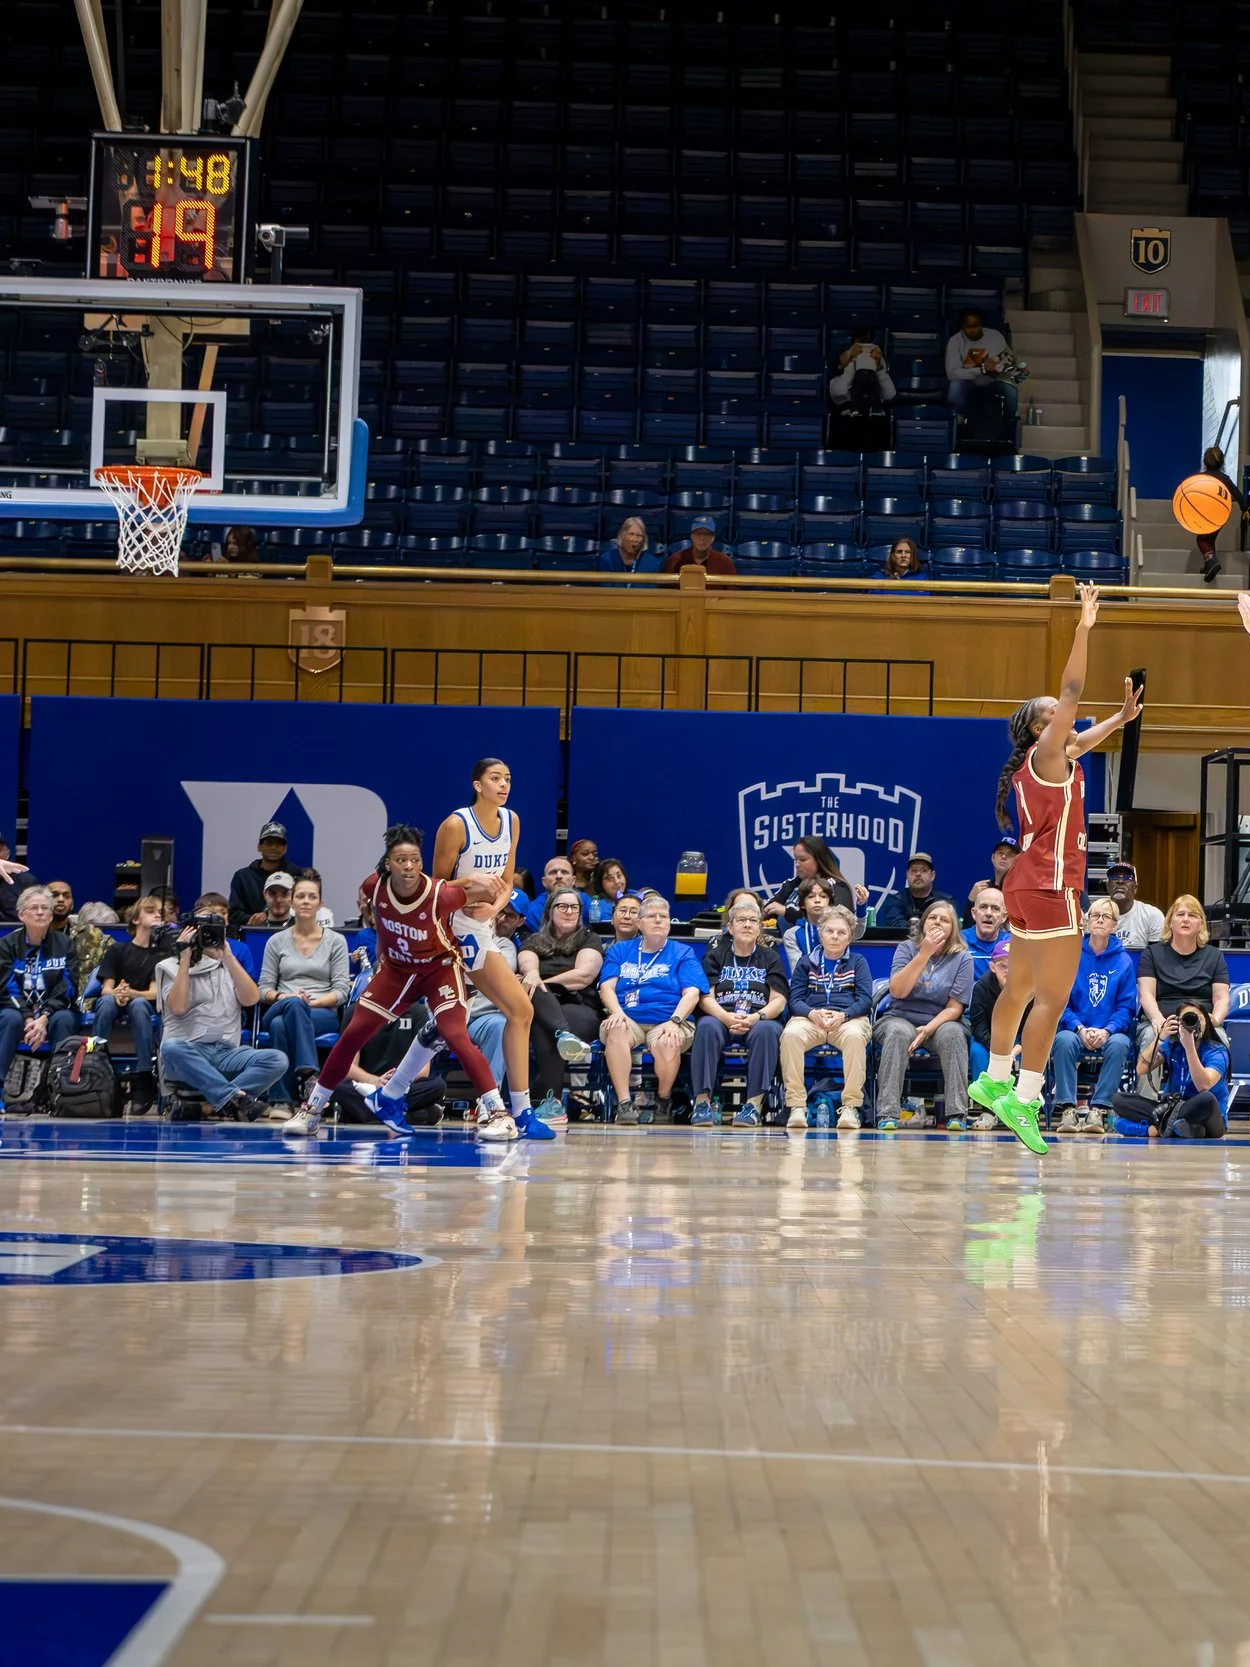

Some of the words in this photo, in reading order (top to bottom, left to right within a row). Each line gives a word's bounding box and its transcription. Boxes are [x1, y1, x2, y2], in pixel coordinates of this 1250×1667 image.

[153, 154, 231, 195] 1:48
[151, 200, 216, 269] 19
[1137, 239, 1165, 265] 10
[1133, 291, 1163, 313] EXIT
[300, 624, 336, 659] 18
[821, 796, 839, 808] THE
[753, 812, 904, 853] SISTERHOOD
[473, 853, 508, 869] DUKE
